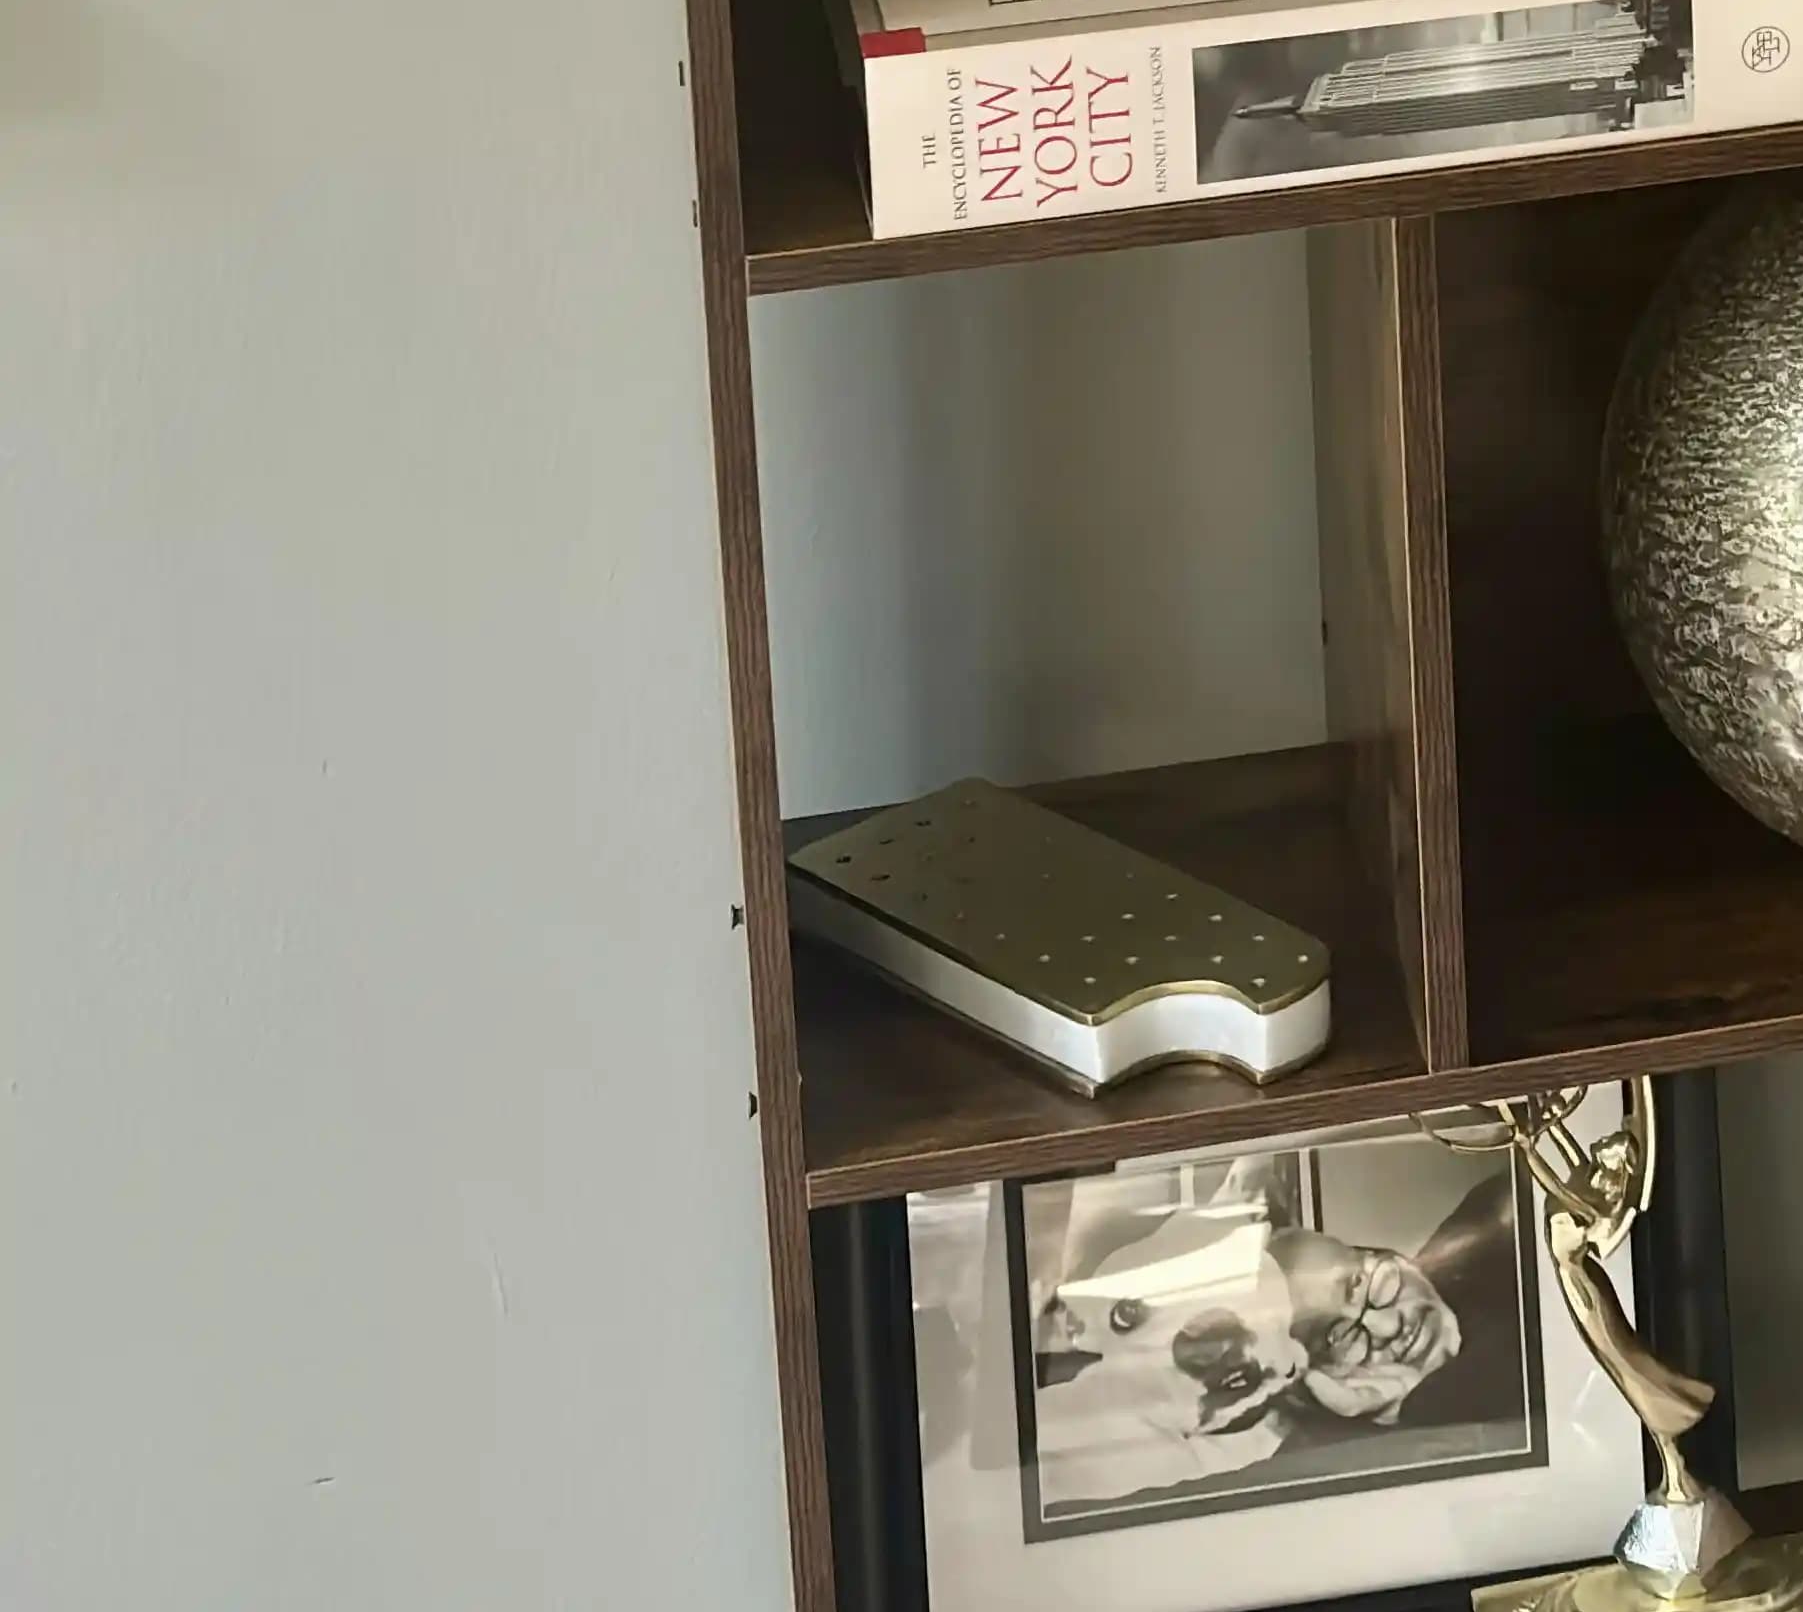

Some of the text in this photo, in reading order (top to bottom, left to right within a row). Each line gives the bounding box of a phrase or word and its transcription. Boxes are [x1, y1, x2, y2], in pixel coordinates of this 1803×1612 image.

[975, 77, 1023, 202] NEW
[1030, 54, 1079, 207] YORK
[1085, 66, 1133, 187] CITY
[1149, 46, 1164, 112] JACKSON
[922, 133, 936, 168] THE
[947, 68, 968, 220] ENCYCLOPEDIA OF
[1152, 130, 1168, 193] KENNETH
